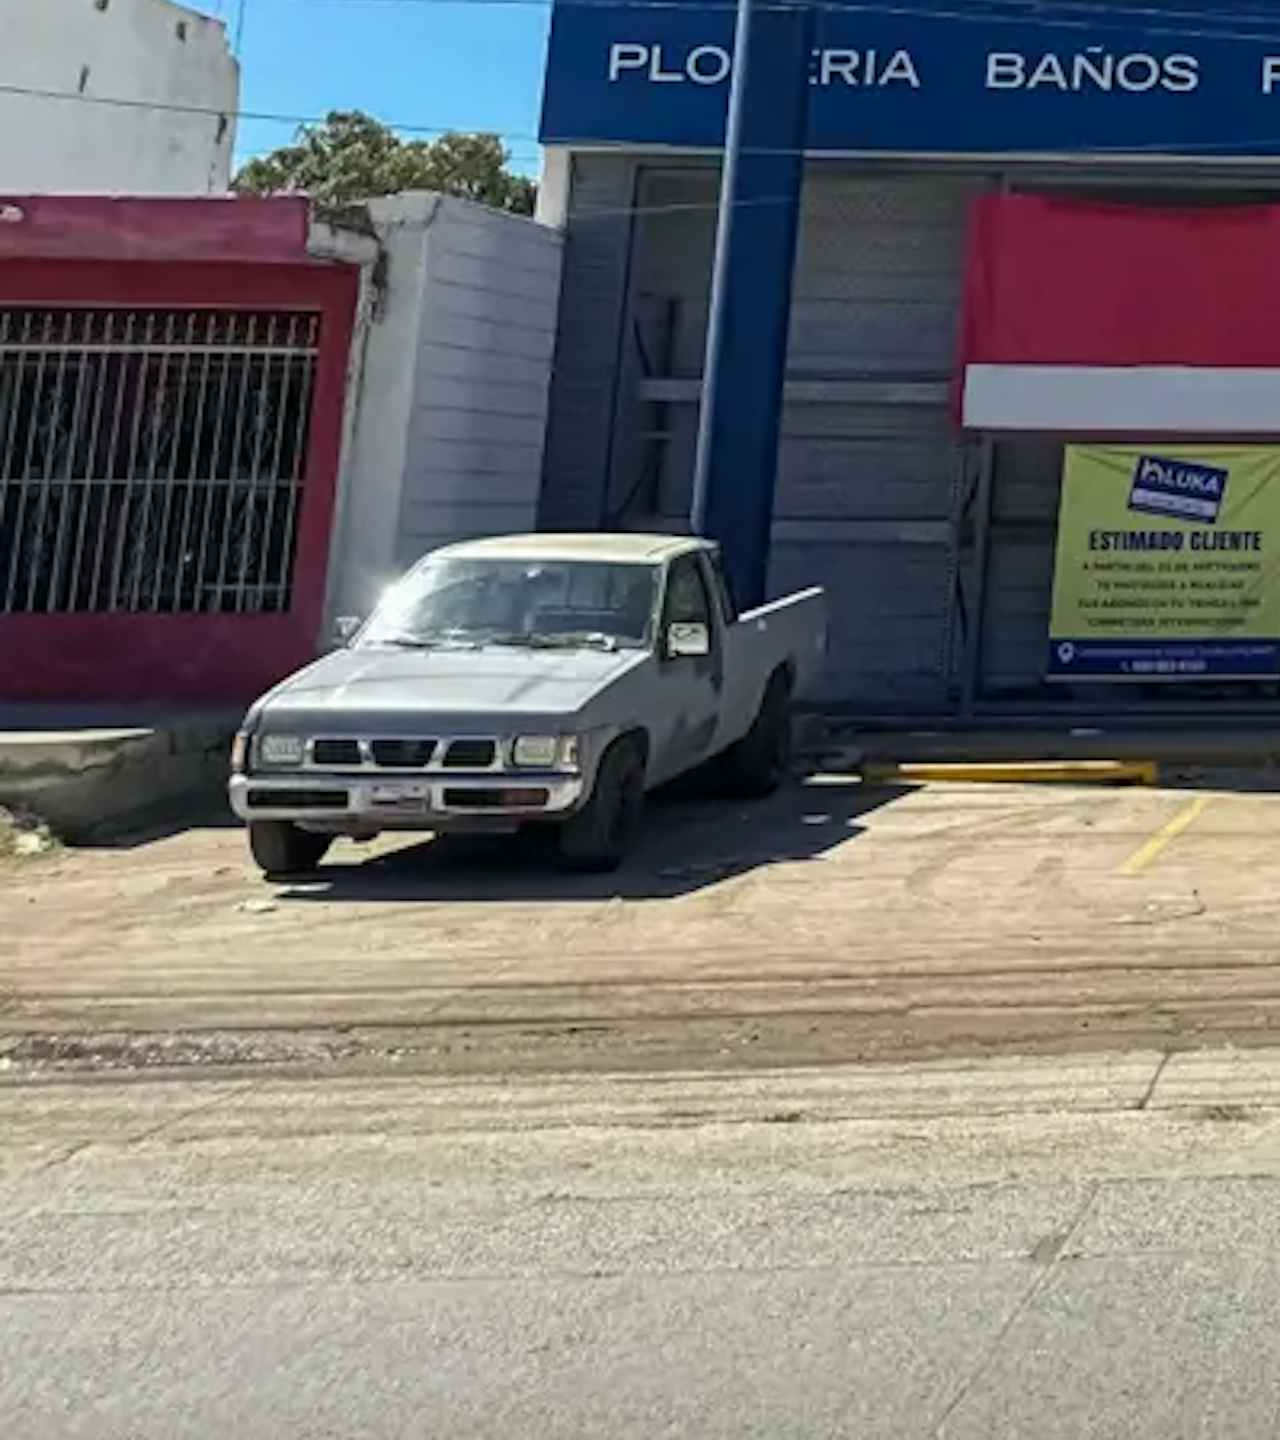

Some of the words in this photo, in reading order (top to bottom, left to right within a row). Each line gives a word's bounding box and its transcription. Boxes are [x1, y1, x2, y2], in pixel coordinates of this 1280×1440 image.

[608, 42, 921, 89] PLORIA
[984, 47, 1201, 93] BAÑOS
[1089, 530, 1185, 552] ESTIMADO
[1189, 530, 1264, 552] CLIENTE
